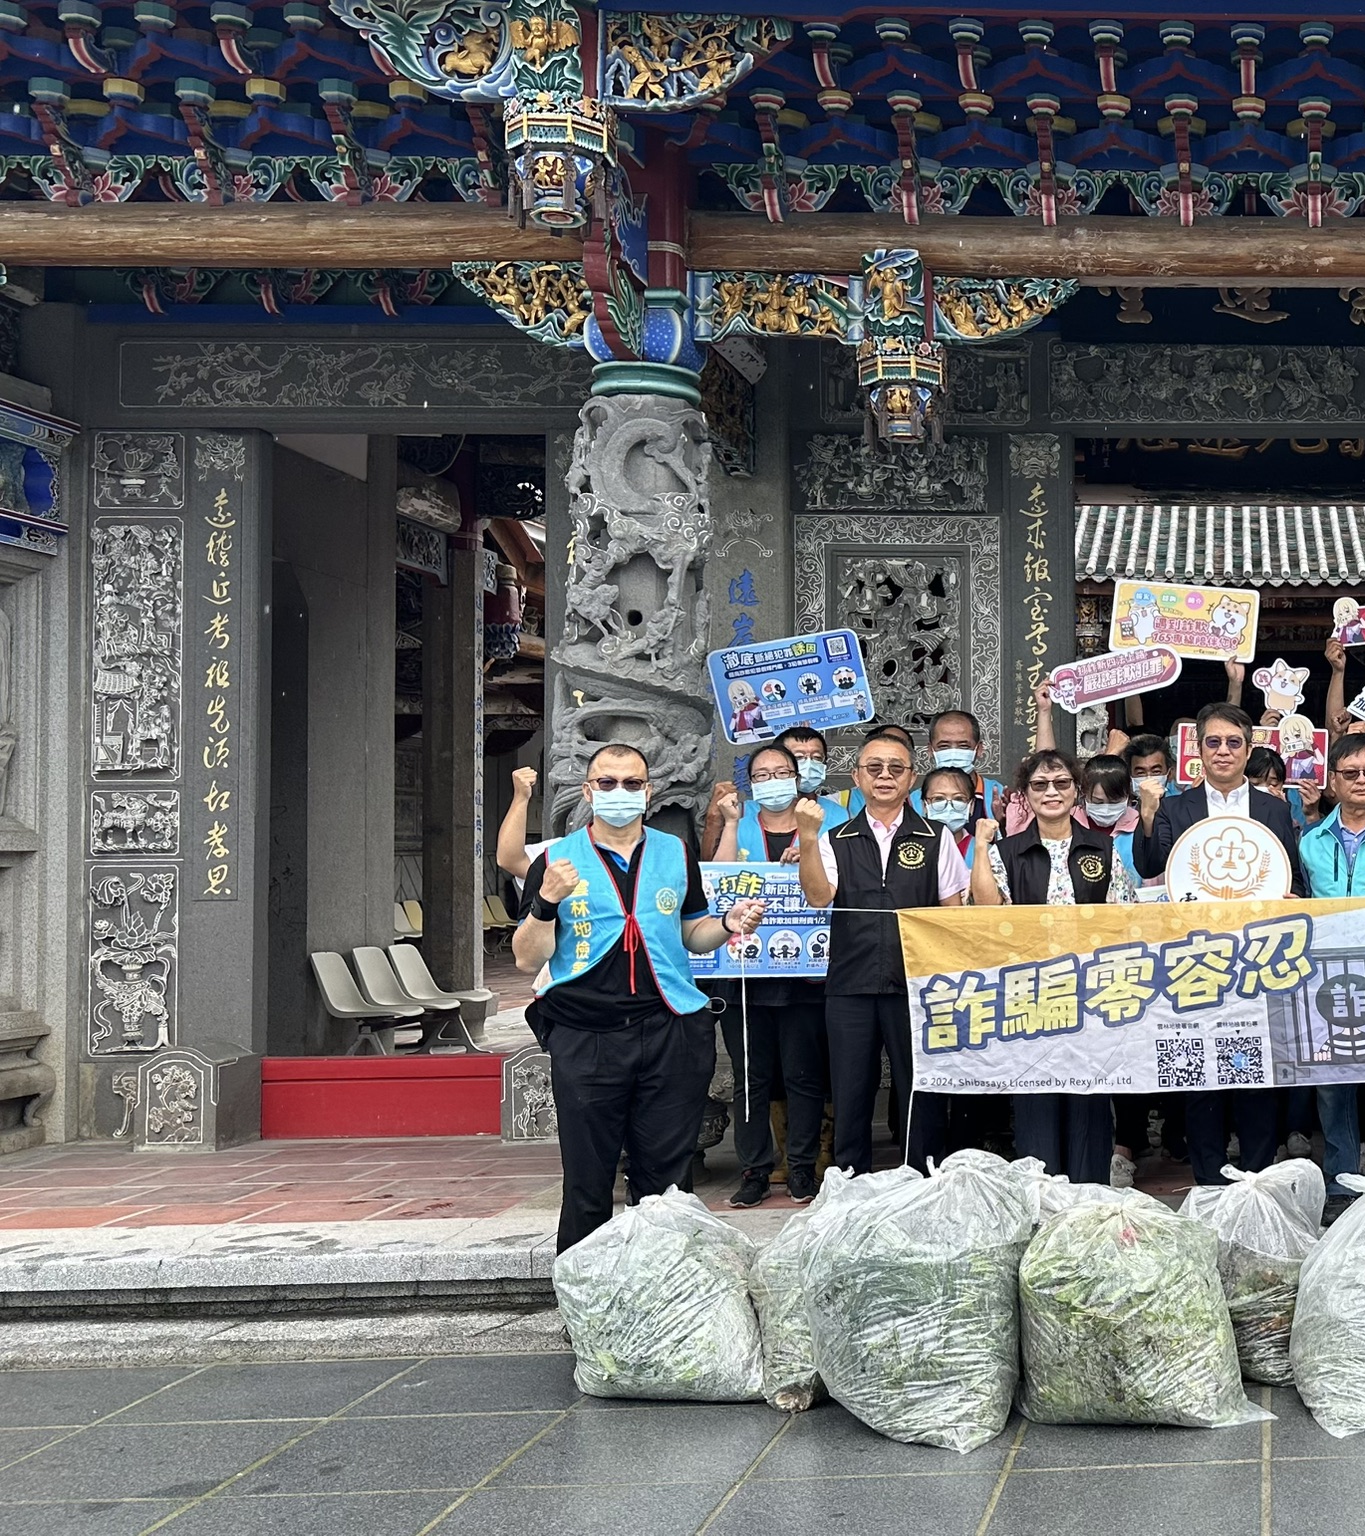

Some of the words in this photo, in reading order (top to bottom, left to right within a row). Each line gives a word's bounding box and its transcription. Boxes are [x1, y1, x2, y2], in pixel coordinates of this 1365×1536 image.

[1154, 617, 1209, 633] 遇到詐欺
[923, 915, 1315, 1052] 詐騙零容忍
[931, 1077, 956, 1087] 2024,
[959, 1078, 1007, 1089] Shibasays
[1009, 1077, 1052, 1088] Licensed
[1055, 1077, 1067, 1089] by
[1069, 1077, 1092, 1088] Rexy
